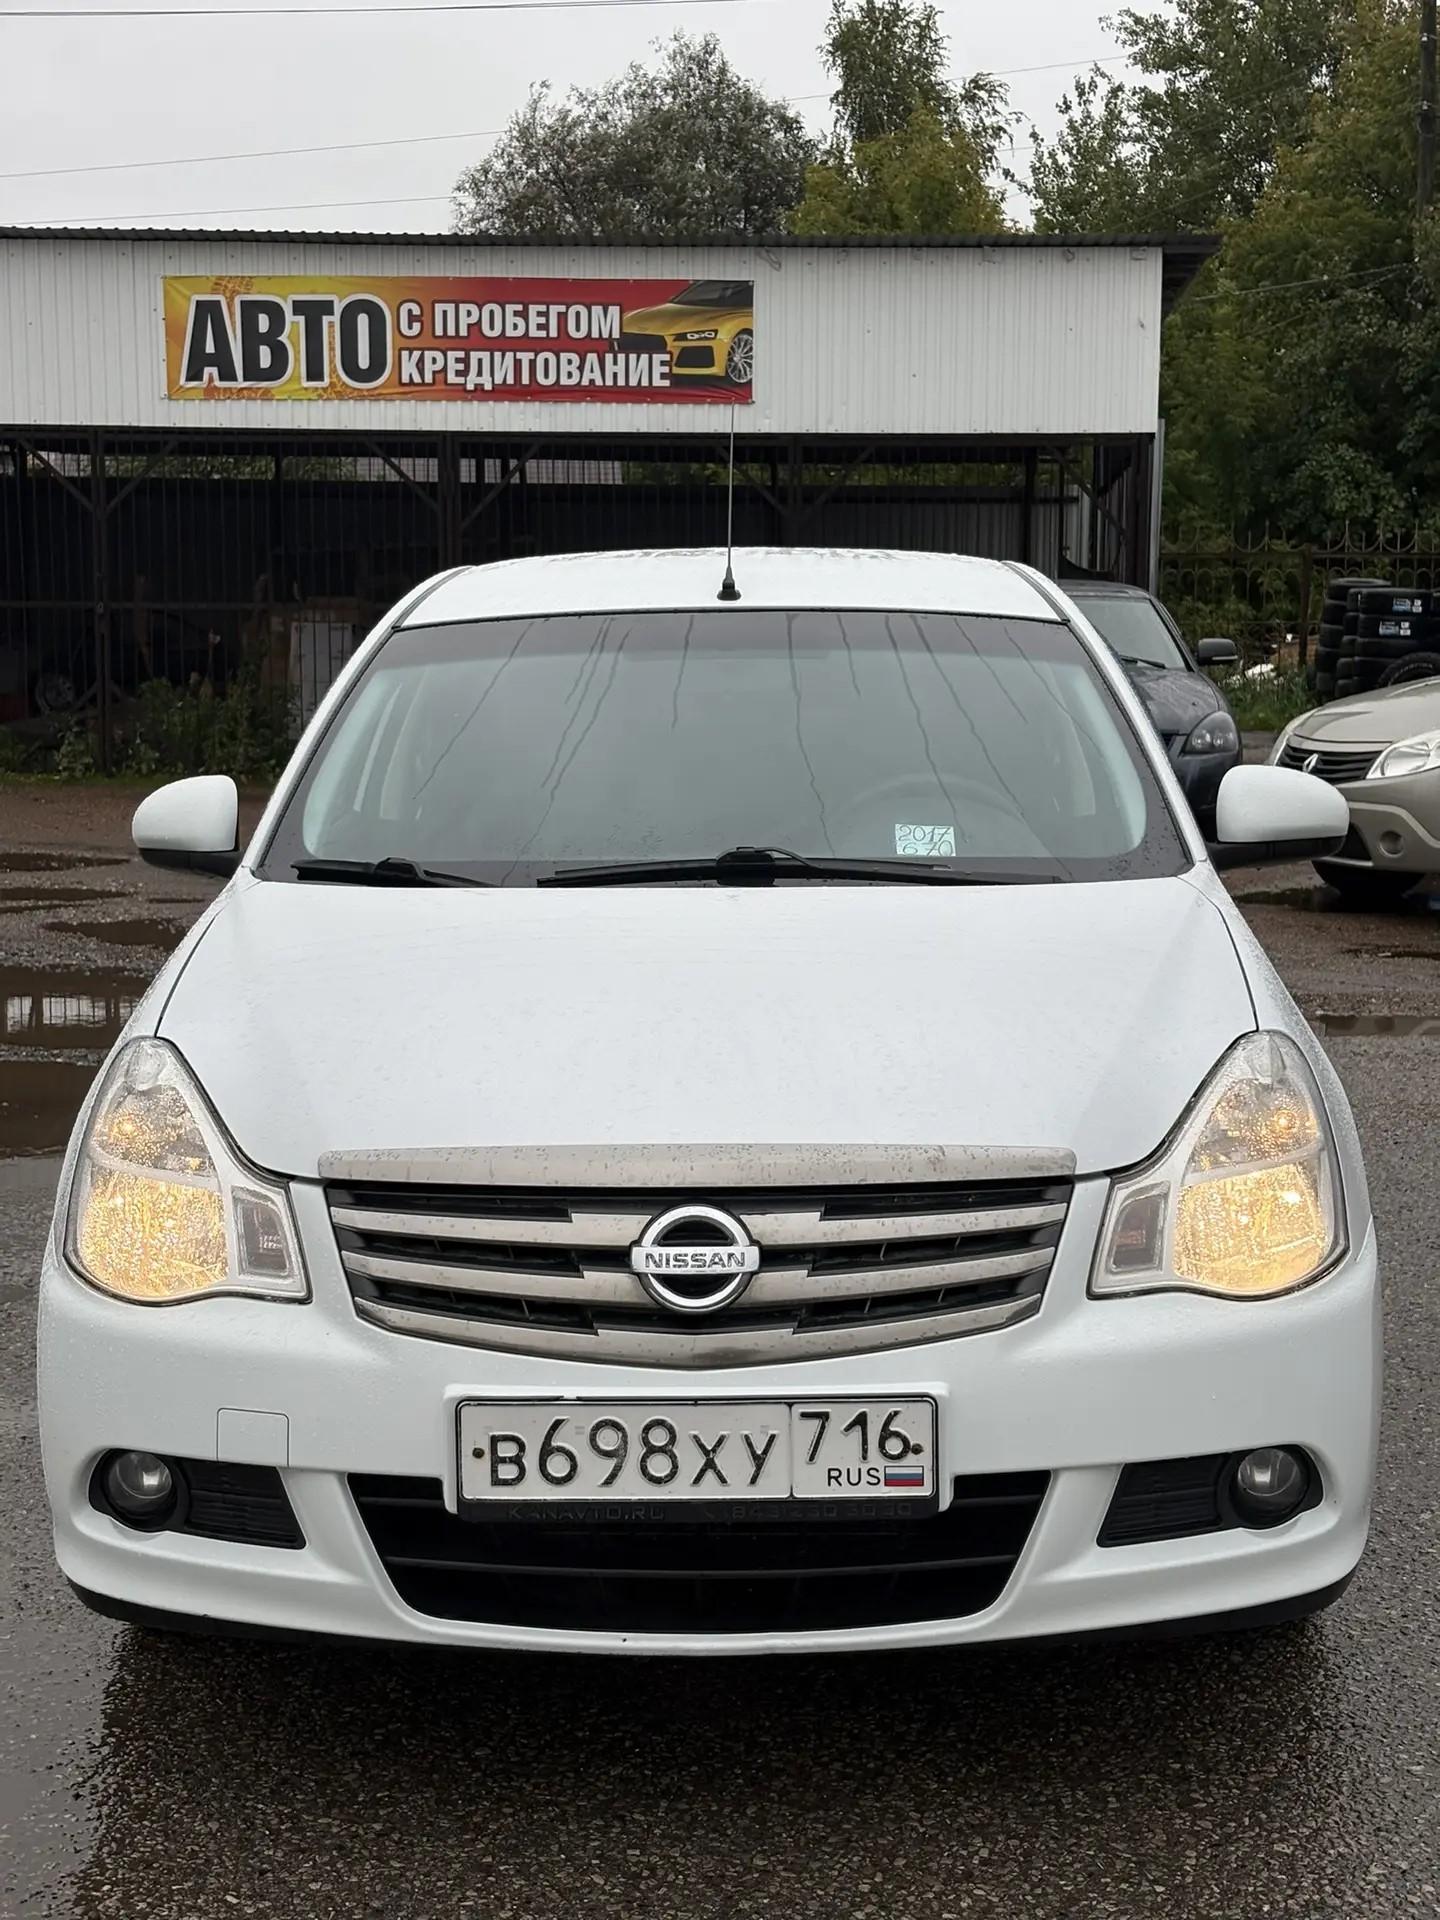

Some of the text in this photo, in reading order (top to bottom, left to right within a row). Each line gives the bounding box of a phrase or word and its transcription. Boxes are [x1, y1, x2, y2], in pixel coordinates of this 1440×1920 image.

[399, 302, 621, 339] С ПРОБЕГОМ
[182, 294, 392, 388] АВТО
[401, 351, 671, 390] КРЕДИТОВАНИЕ
[898, 825, 951, 842] 2017
[645, 1252, 745, 1268] NISSAN
[801, 1410, 911, 1461] 716
[828, 1468, 880, 1486] RUS
